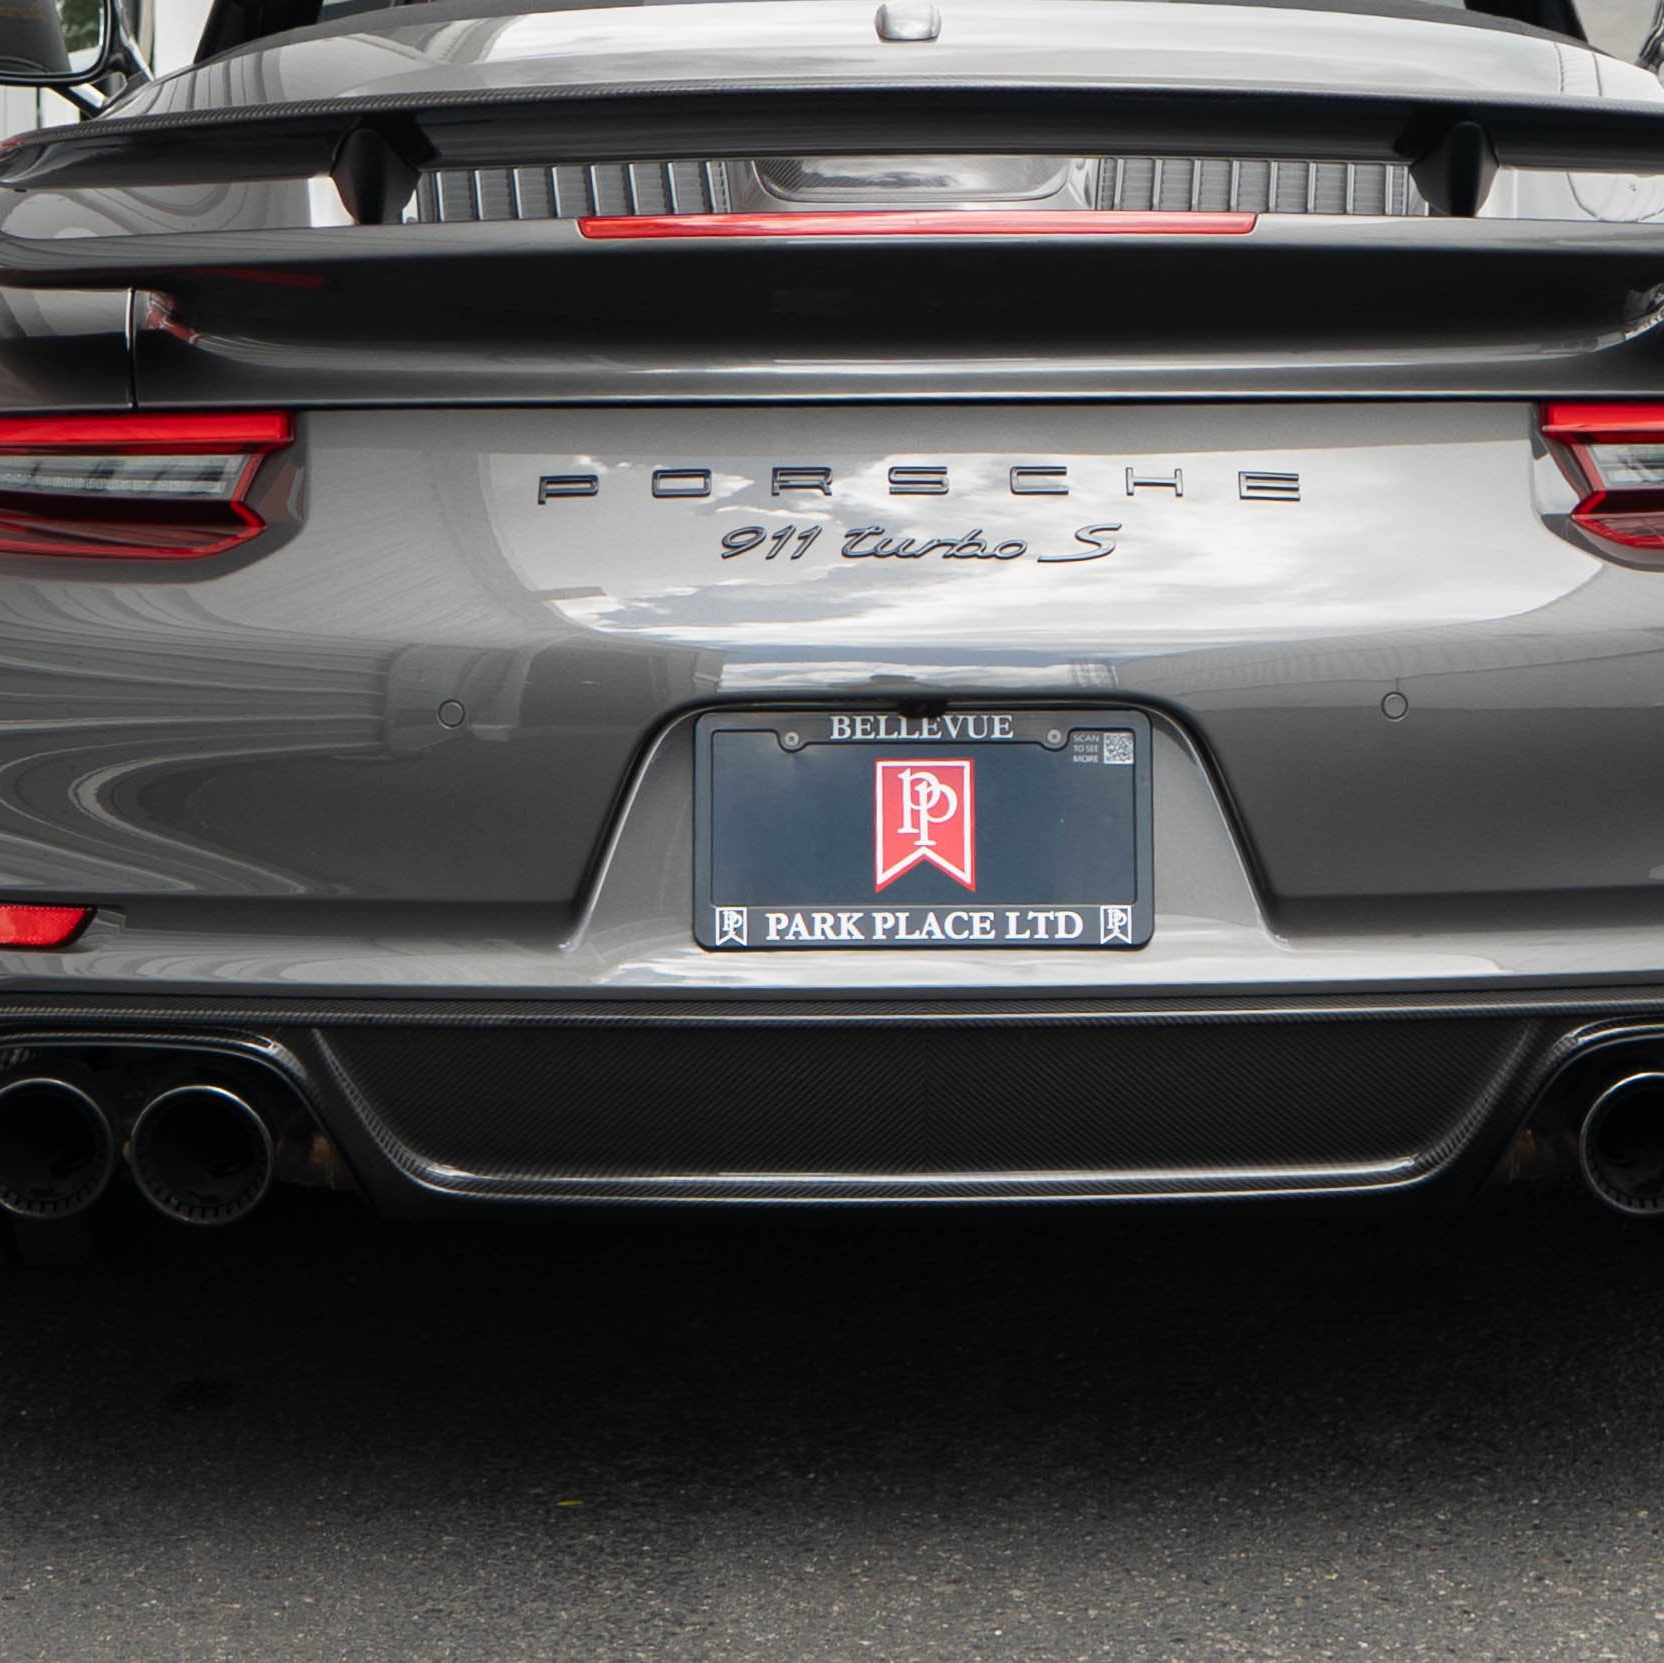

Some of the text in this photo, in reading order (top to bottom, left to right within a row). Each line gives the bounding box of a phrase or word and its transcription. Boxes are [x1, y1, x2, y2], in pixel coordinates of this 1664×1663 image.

[537, 465, 1301, 506] PORSCHE
[721, 523, 1123, 563] 911 turbo S
[830, 715, 1014, 740] BELLEVUE
[1073, 734, 1100, 743] SCAN
[1072, 754, 1099, 764] MORE
[1073, 744, 1099, 753] TO SEE
[765, 911, 1084, 941] PARK PLACE LTD
